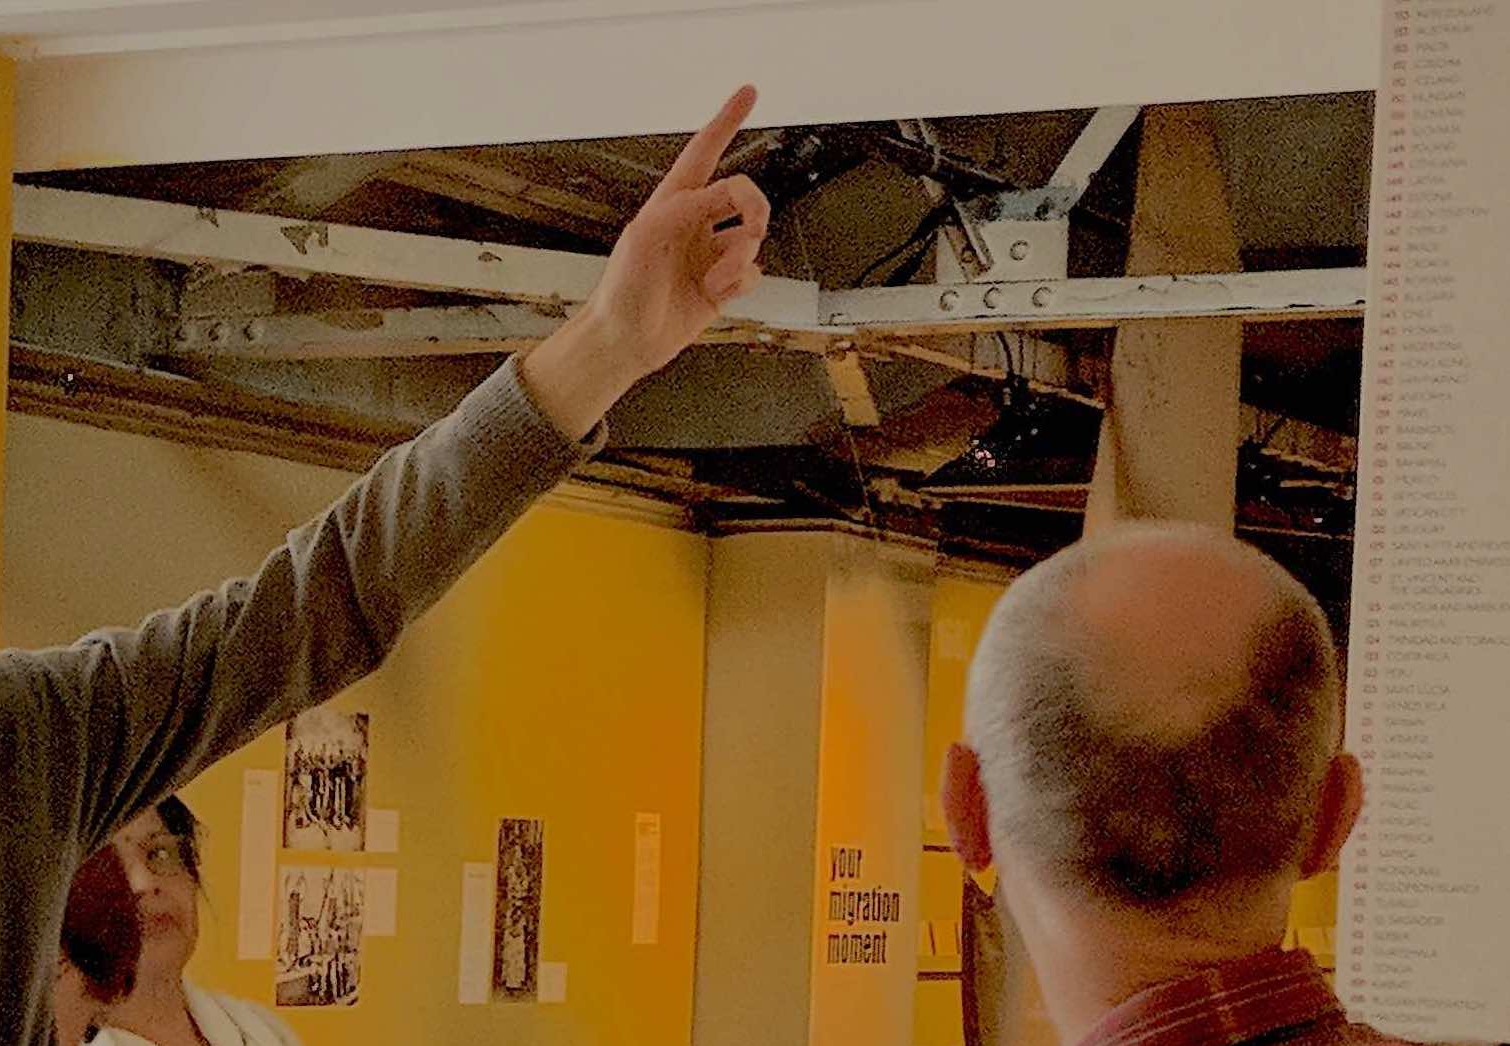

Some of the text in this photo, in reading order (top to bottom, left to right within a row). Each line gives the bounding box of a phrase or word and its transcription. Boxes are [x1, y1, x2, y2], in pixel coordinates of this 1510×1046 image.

[830, 848, 862, 881] your
[829, 886, 900, 926] migration
[827, 930, 888, 964] moment
